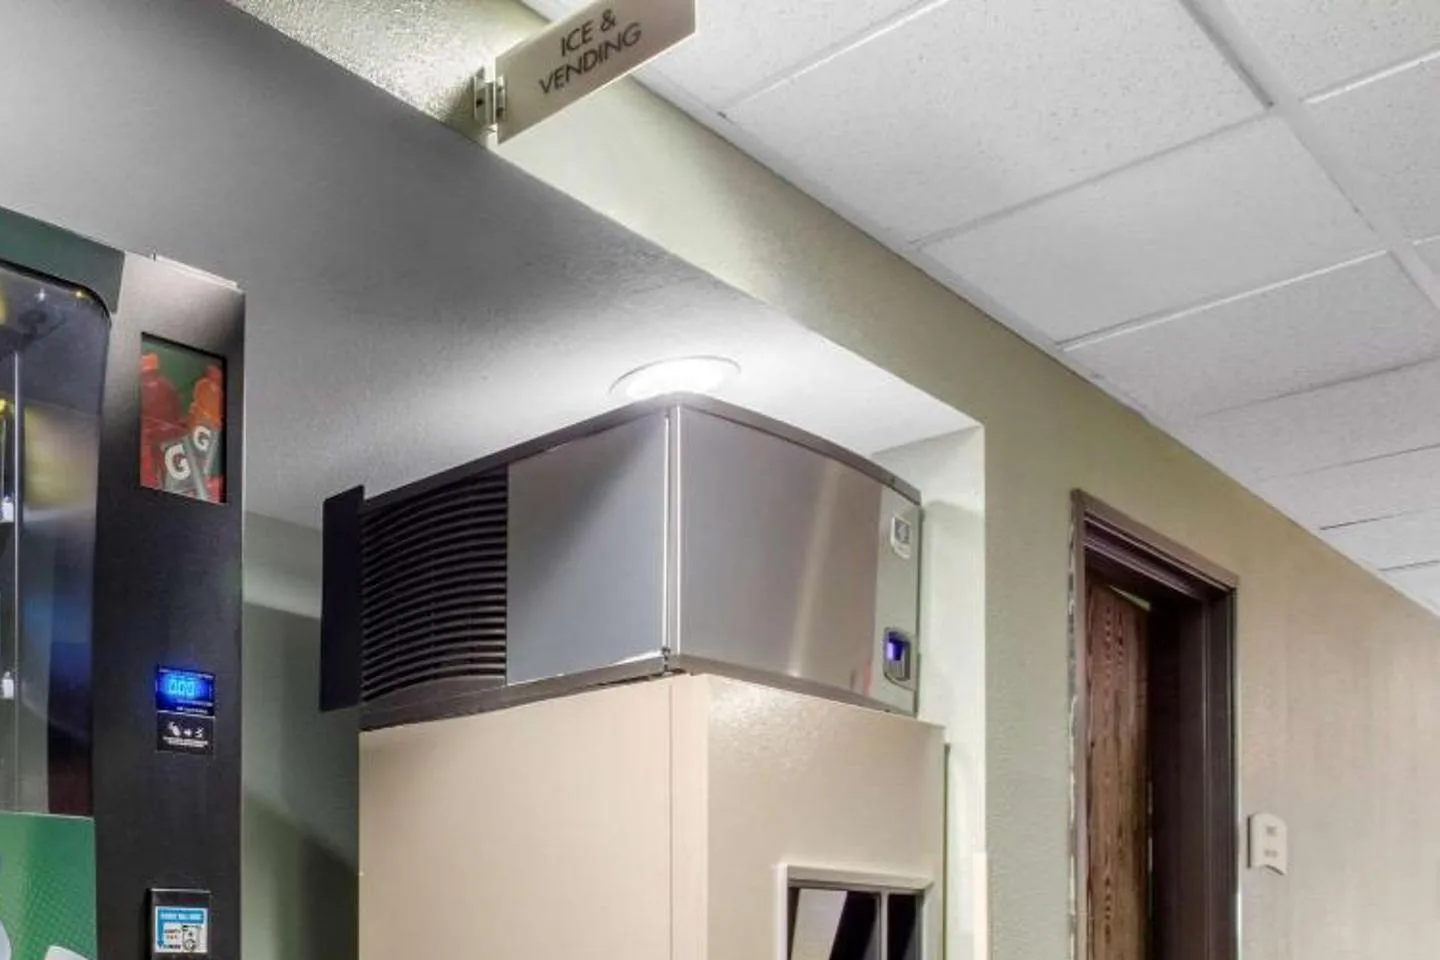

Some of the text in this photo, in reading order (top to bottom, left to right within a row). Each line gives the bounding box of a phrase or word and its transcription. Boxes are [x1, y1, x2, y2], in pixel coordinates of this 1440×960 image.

[561, 9, 617, 56] ICE &
[538, 22, 642, 94] VENDING
[165, 444, 191, 480] G
